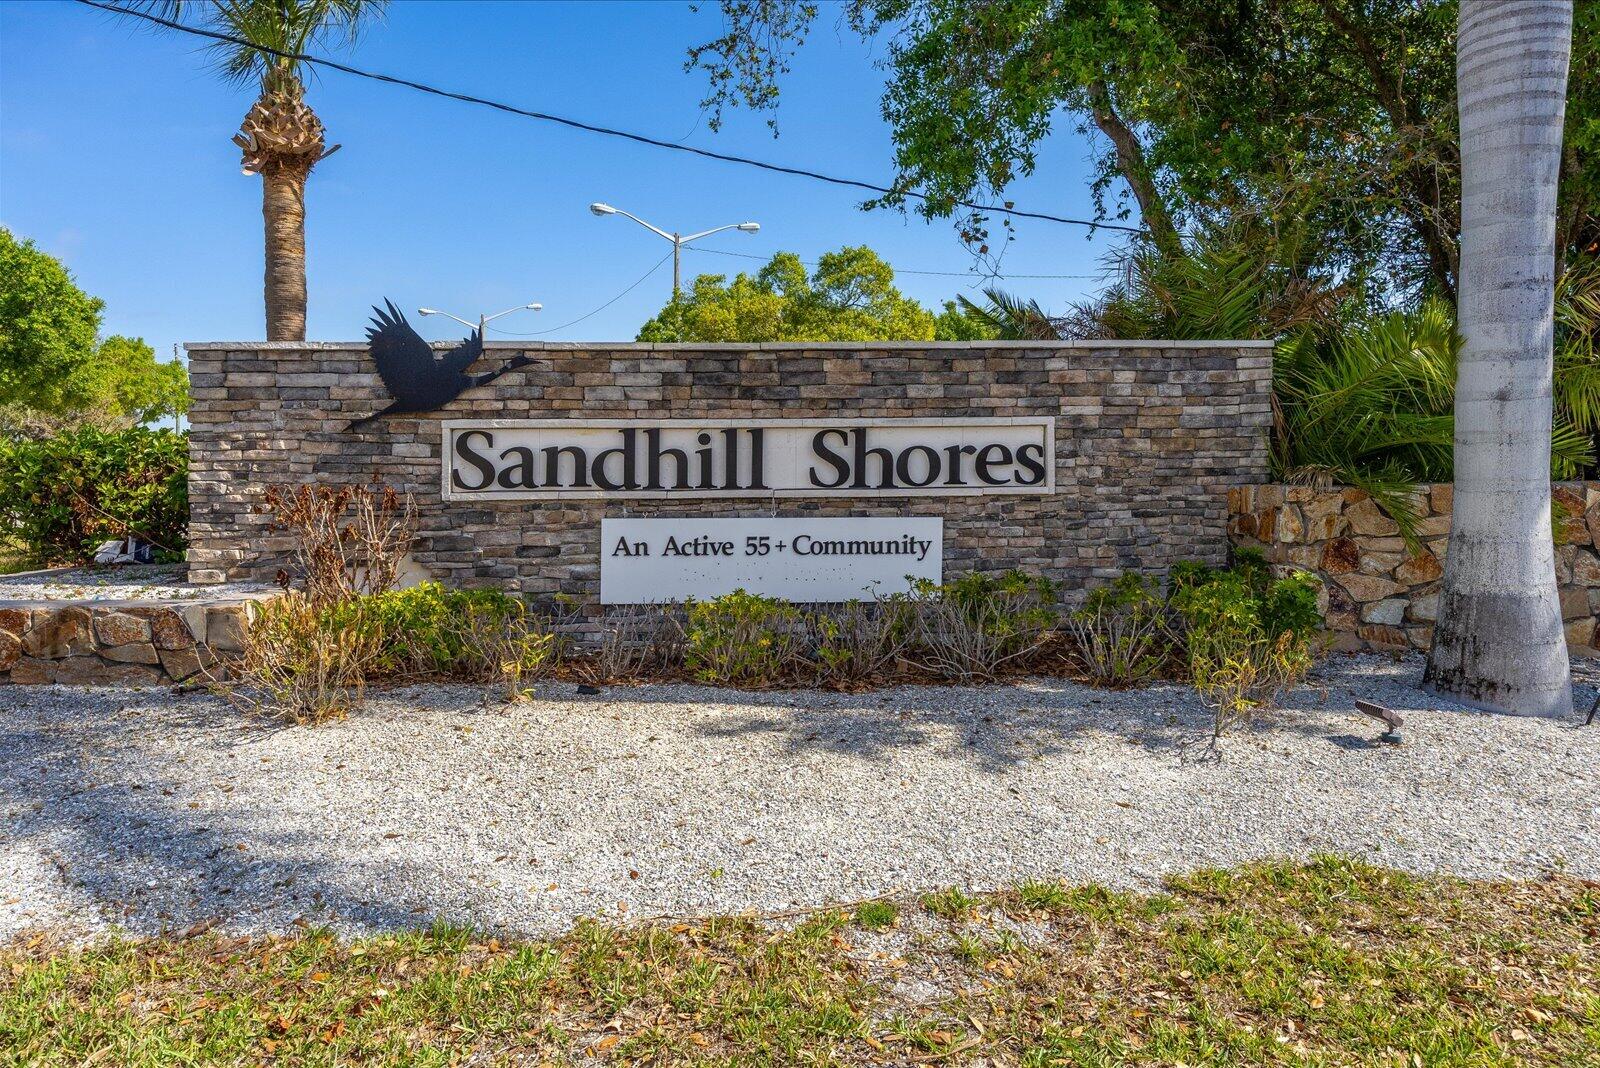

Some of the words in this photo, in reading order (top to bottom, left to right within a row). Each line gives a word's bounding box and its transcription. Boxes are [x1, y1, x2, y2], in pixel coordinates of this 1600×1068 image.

[452, 428, 771, 491] Sandhill
[809, 428, 1046, 487] Shores
[612, 536, 650, 557] An
[661, 535, 734, 557] Active
[792, 534, 932, 561] Community
